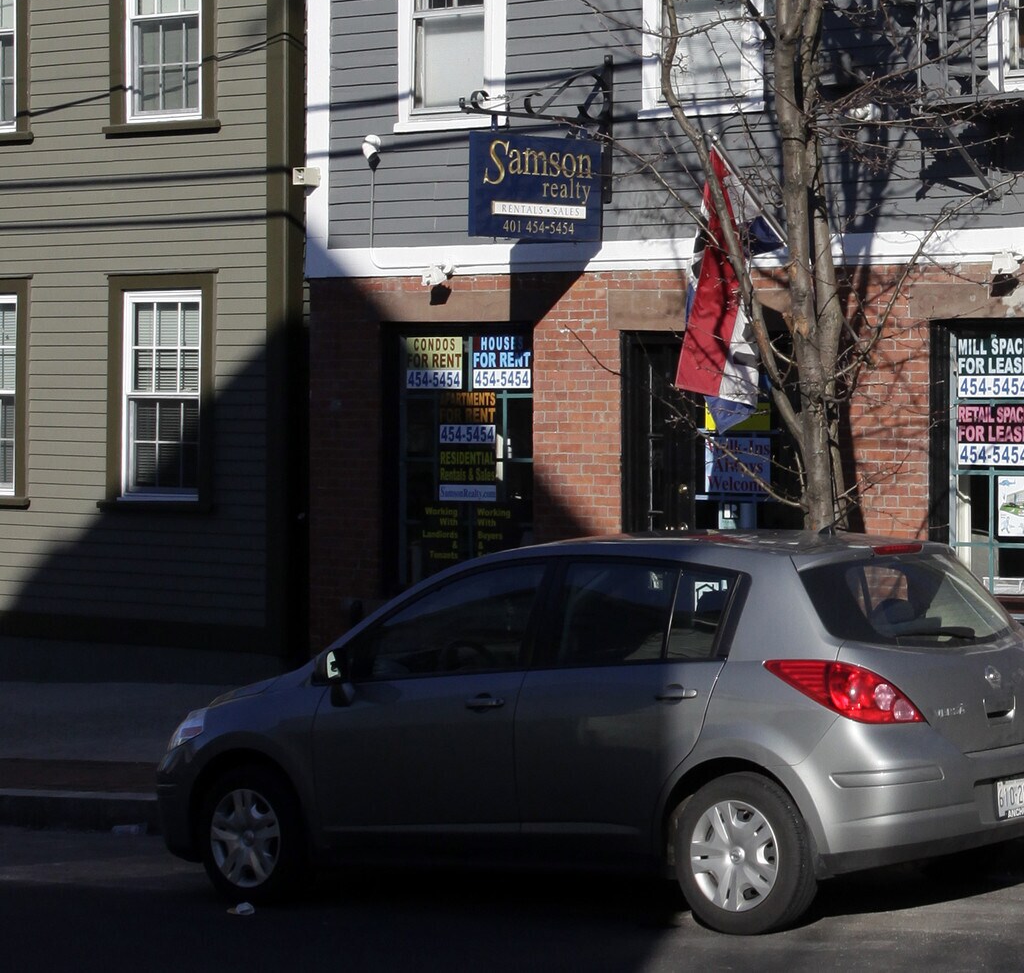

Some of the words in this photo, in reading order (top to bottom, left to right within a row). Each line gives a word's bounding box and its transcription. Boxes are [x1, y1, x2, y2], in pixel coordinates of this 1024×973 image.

[483, 140, 593, 184] Samson
[542, 179, 591, 204] realty
[502, 205, 543, 214] RENTALS
[553, 208, 580, 216] SALES
[503, 220, 521, 233] 401
[526, 221, 574, 234] 454-5454
[414, 338, 455, 351] CONDOS
[958, 339, 987, 355] MILL
[408, 354, 428, 368] FOR
[433, 354, 461, 368] RENT
[474, 353, 496, 367] FOR
[500, 352, 530, 367] RENT
[958, 358, 985, 374] FOR
[408, 372, 460, 387] 454-5454
[475, 371, 528, 387] 454-5454
[466, 408, 495, 422] RENT
[958, 407, 995, 423] RETAIL
[441, 427, 494, 442] 454-5454
[958, 426, 985, 442] FOR
[440, 451, 494, 465] RESIDENTIAL
[440, 468, 466, 481] Rentals
[469, 469, 474, 481] &
[476, 469, 496, 481] Sales
[708, 476, 768, 493] Welcom
[425, 508, 458, 517] Working
[477, 508, 511, 518] Working
[440, 518, 458, 526] With
[477, 519, 496, 527] With
[423, 530, 458, 538] Landlords
[478, 532, 502, 540] Buyers
[430, 551, 458, 559] Tenants
